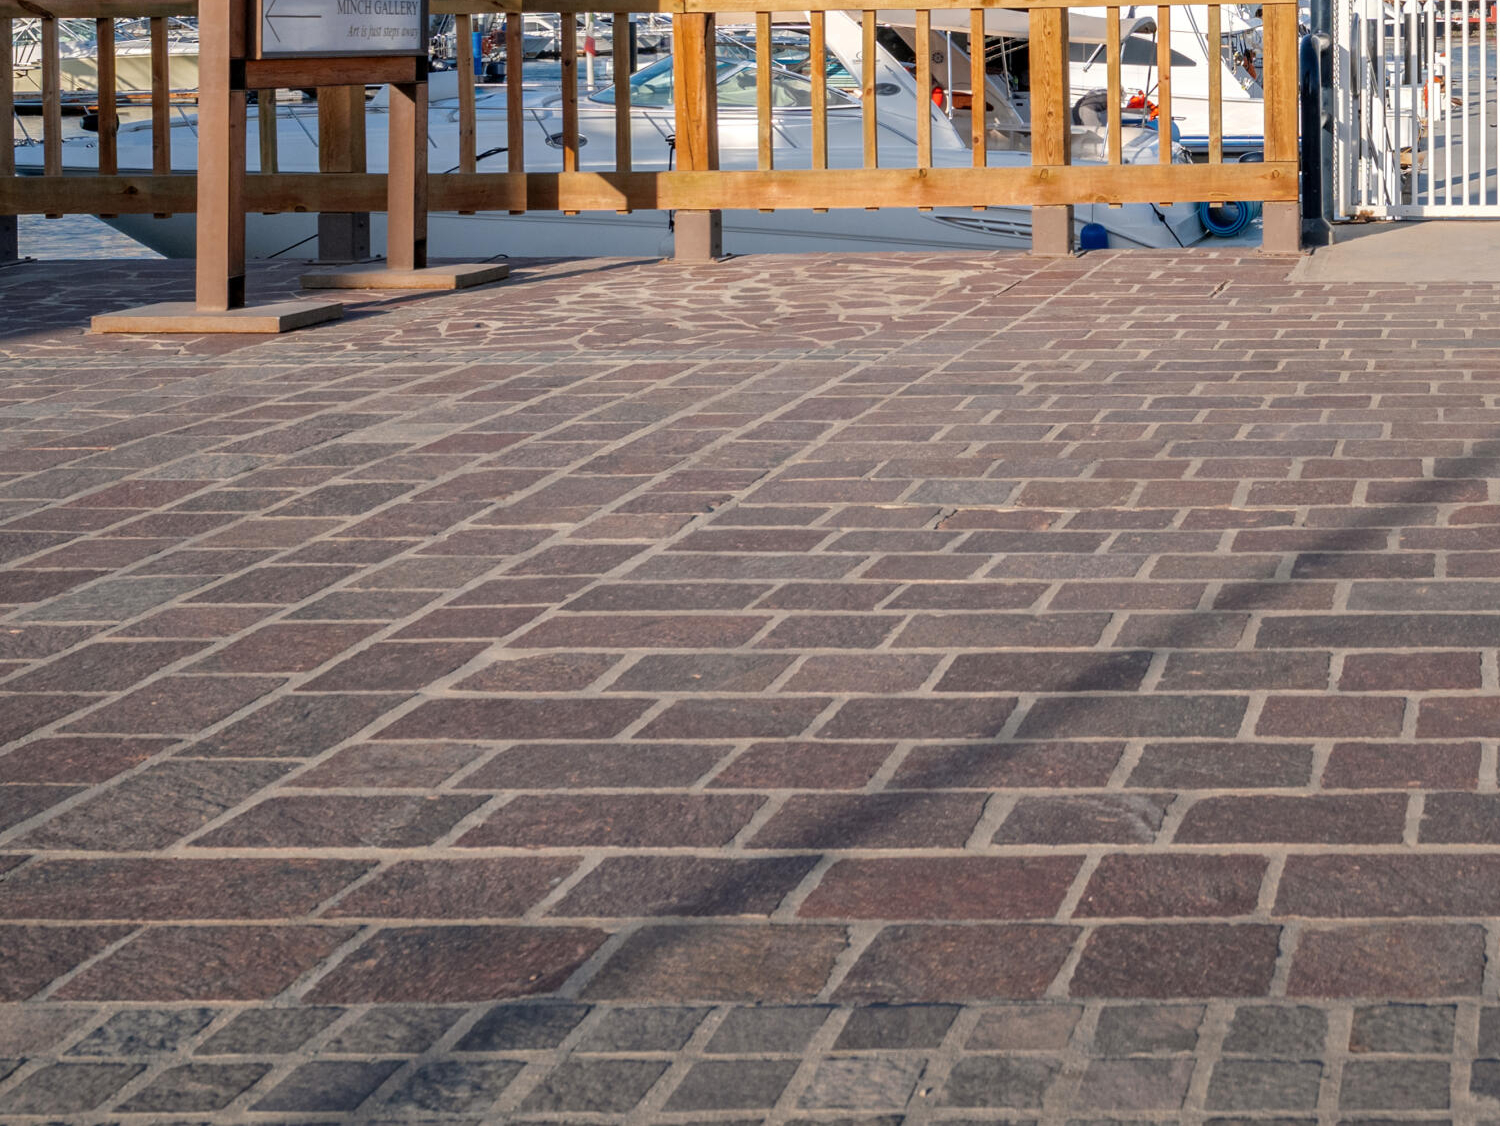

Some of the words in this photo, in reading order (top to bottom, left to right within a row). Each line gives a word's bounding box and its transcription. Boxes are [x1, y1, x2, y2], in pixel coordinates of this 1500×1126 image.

[336, 0, 372, 15] MINCH
[374, 0, 419, 16] GALLERY
[347, 25, 360, 37] Art
[360, 25, 367, 37] is
[366, 25, 382, 40] just
[383, 26, 400, 40] steps
